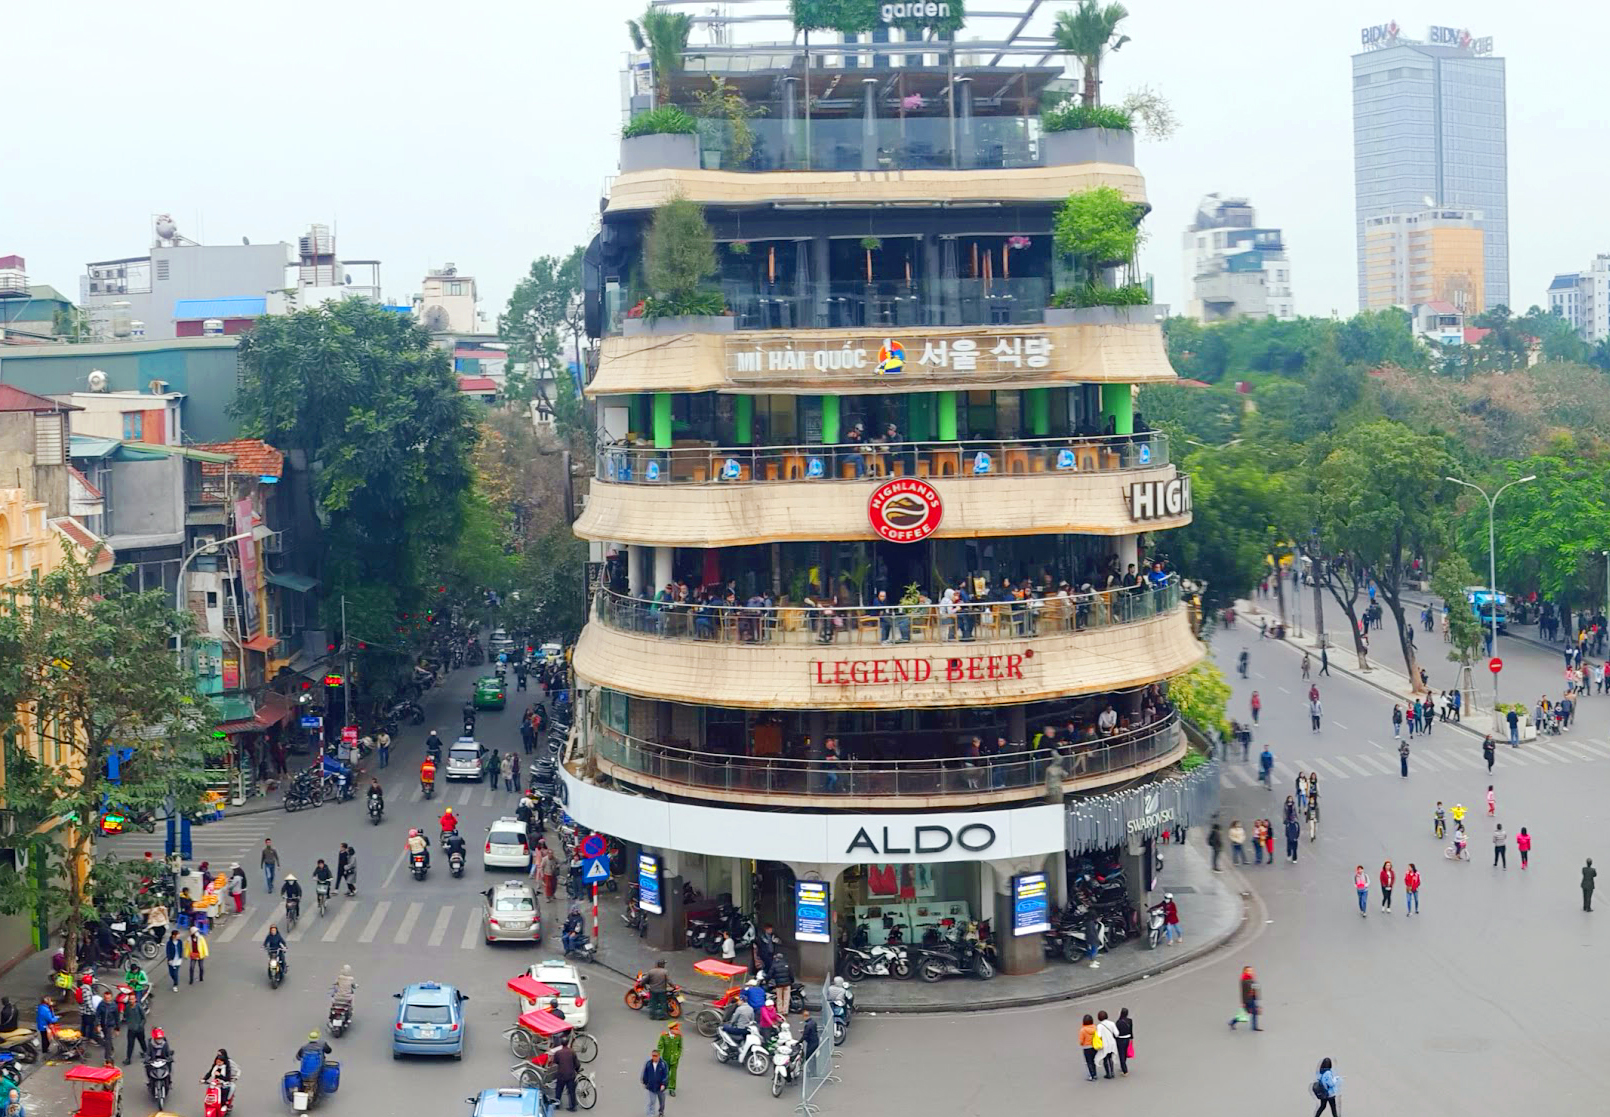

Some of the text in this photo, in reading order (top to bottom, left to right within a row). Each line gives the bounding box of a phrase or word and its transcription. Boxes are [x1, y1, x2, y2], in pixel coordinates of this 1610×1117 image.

[882, 0, 951, 22] garden
[1361, 23, 1388, 45] BIDV
[1430, 25, 1461, 45] BIDV
[738, 347, 761, 371] MÌ
[813, 340, 867, 370] QUỐC
[918, 338, 1053, 370] 서울 식당
[872, 482, 940, 509] HIGHLANDS
[880, 523, 932, 540] COFFEE
[816, 653, 1023, 684] LEGEND BEER
[1126, 808, 1174, 834] SWAROVSKI
[845, 823, 996, 854] ALDO
